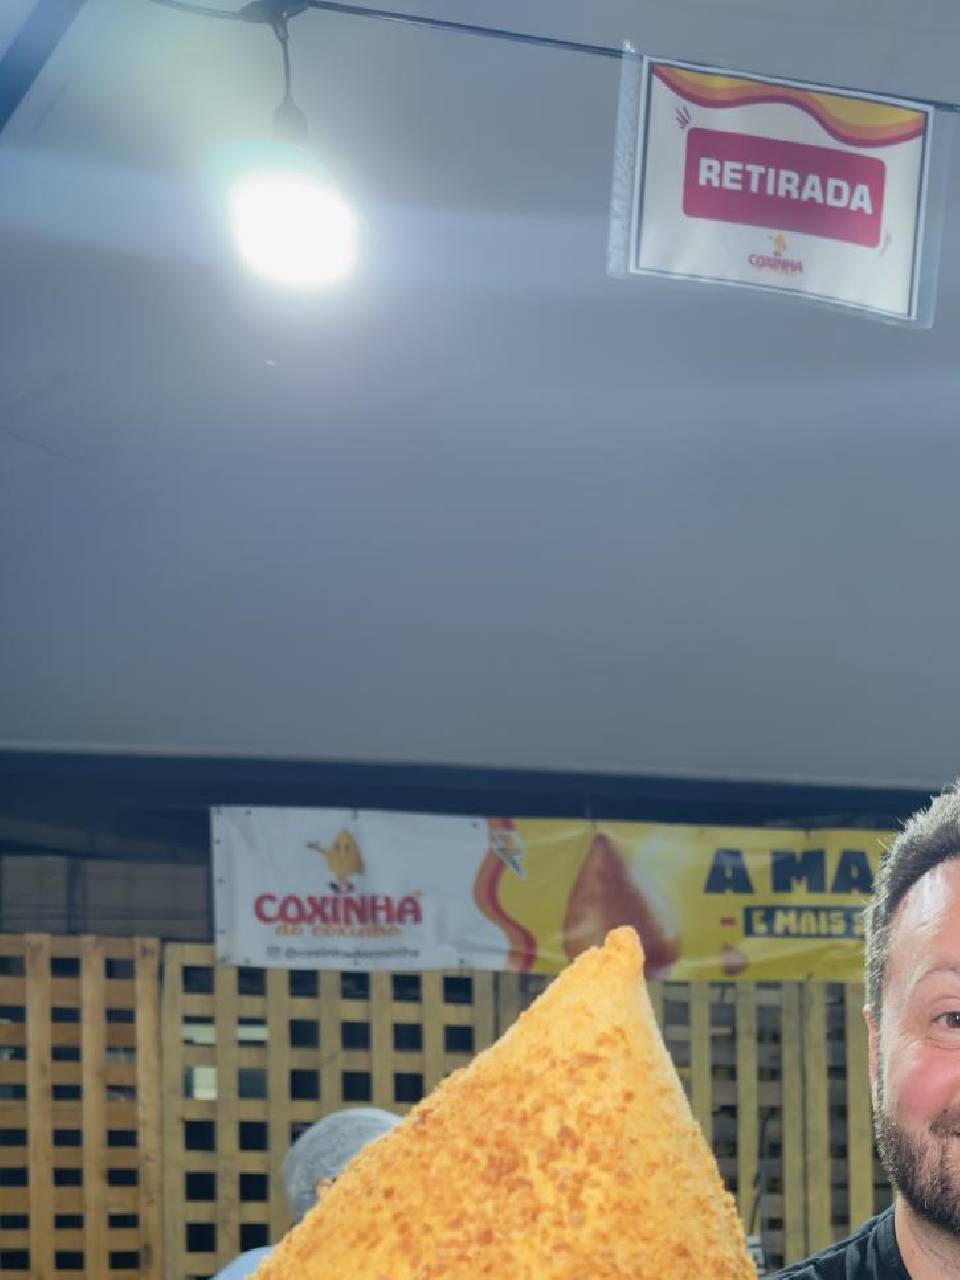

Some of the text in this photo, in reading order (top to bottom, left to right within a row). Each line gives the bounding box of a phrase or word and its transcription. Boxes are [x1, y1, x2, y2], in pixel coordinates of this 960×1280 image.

[698, 157, 873, 215] RETIRADA
[703, 848, 874, 894] A MA
[254, 892, 423, 925] COXINHA
[774, 909, 845, 935] MAIS
